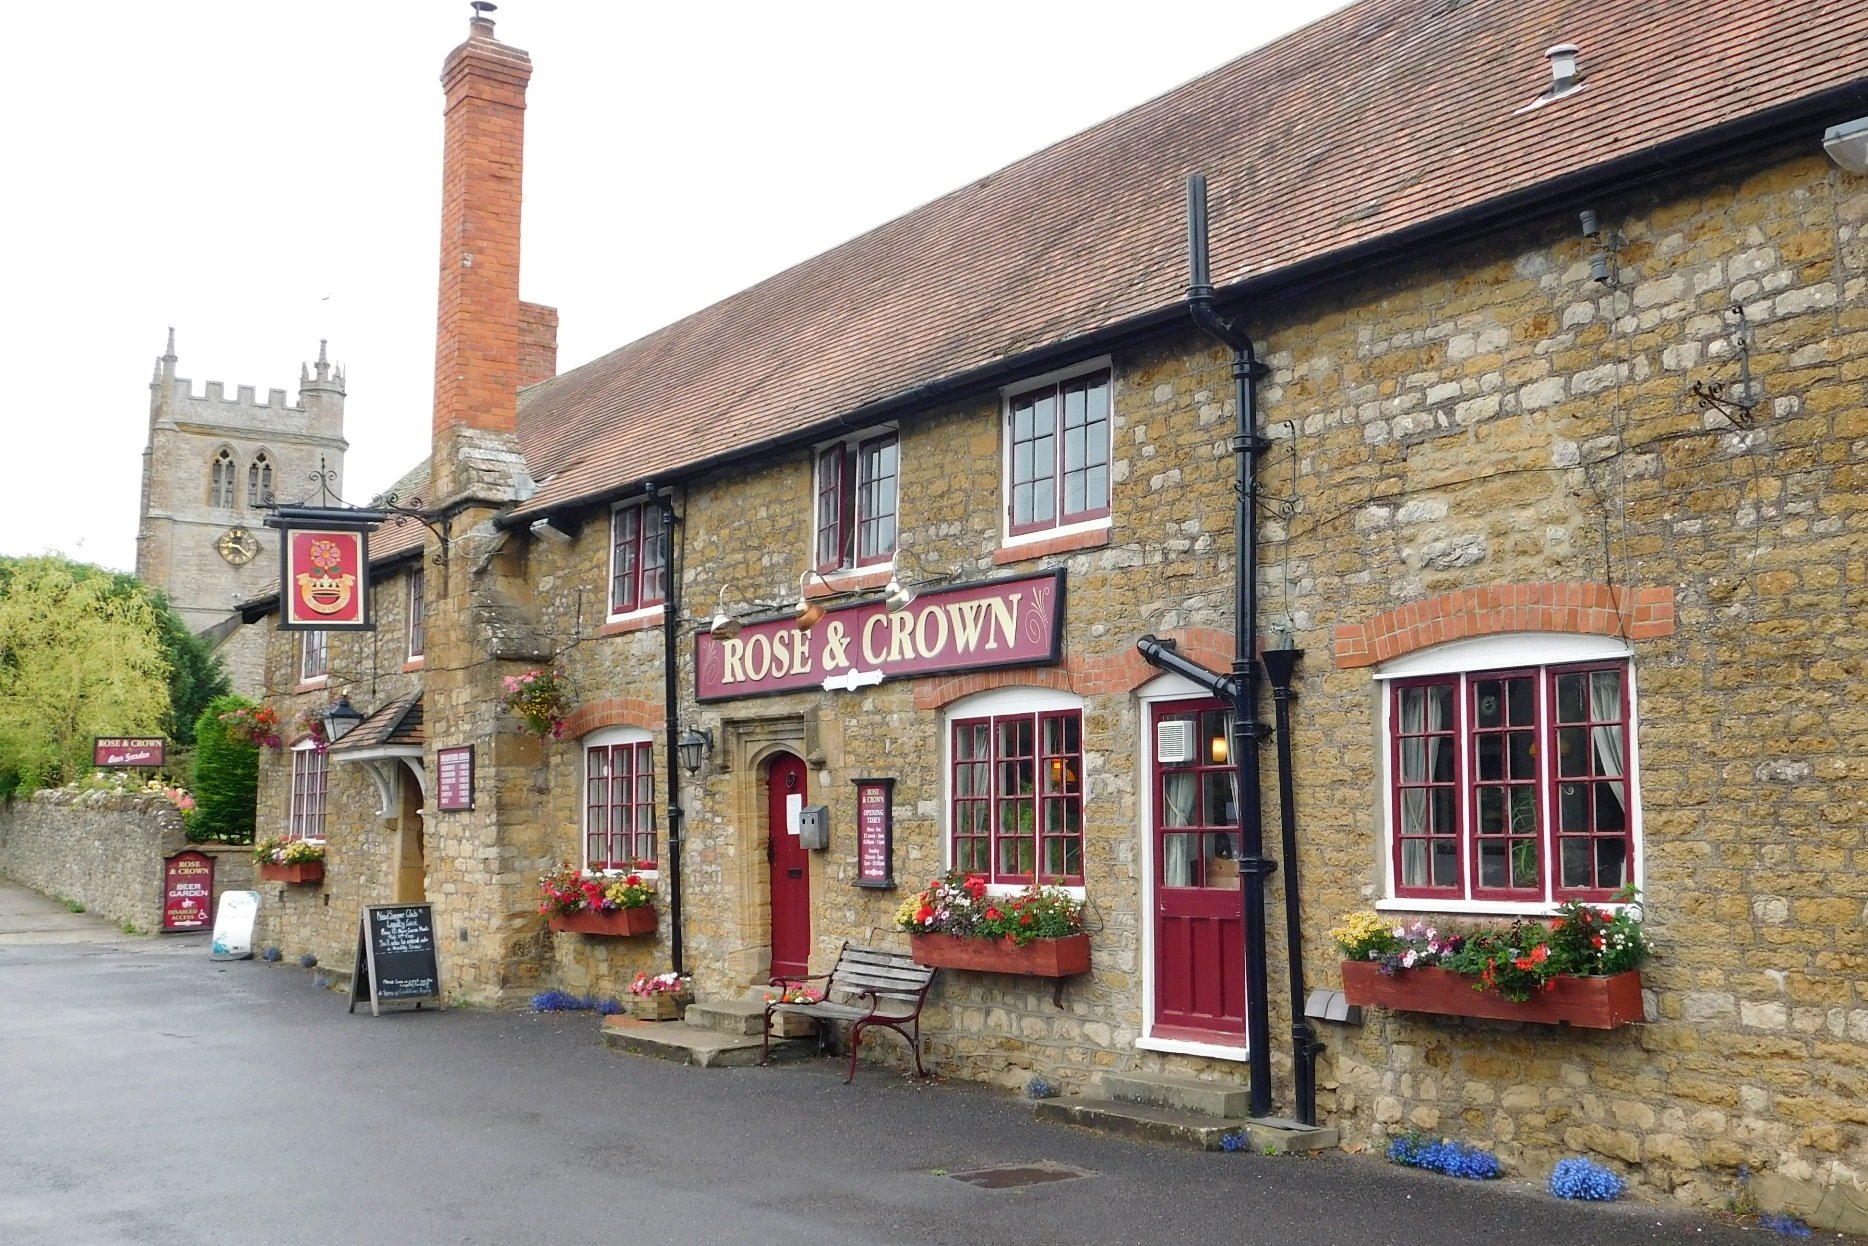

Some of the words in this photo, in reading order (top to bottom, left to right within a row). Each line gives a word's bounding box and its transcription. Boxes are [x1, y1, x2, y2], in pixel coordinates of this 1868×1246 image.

[721, 628, 813, 684] ROSE
[822, 620, 851, 671] &
[862, 593, 1022, 665] CROWN
[98, 739, 121, 747] ROSE
[122, 739, 129, 747] &
[130, 739, 162, 748] CROWN
[866, 788, 880, 796] ROSE
[867, 796, 885, 804] CROWN
[866, 816, 881, 824] TIMES
[178, 867, 209, 875] CROWN
